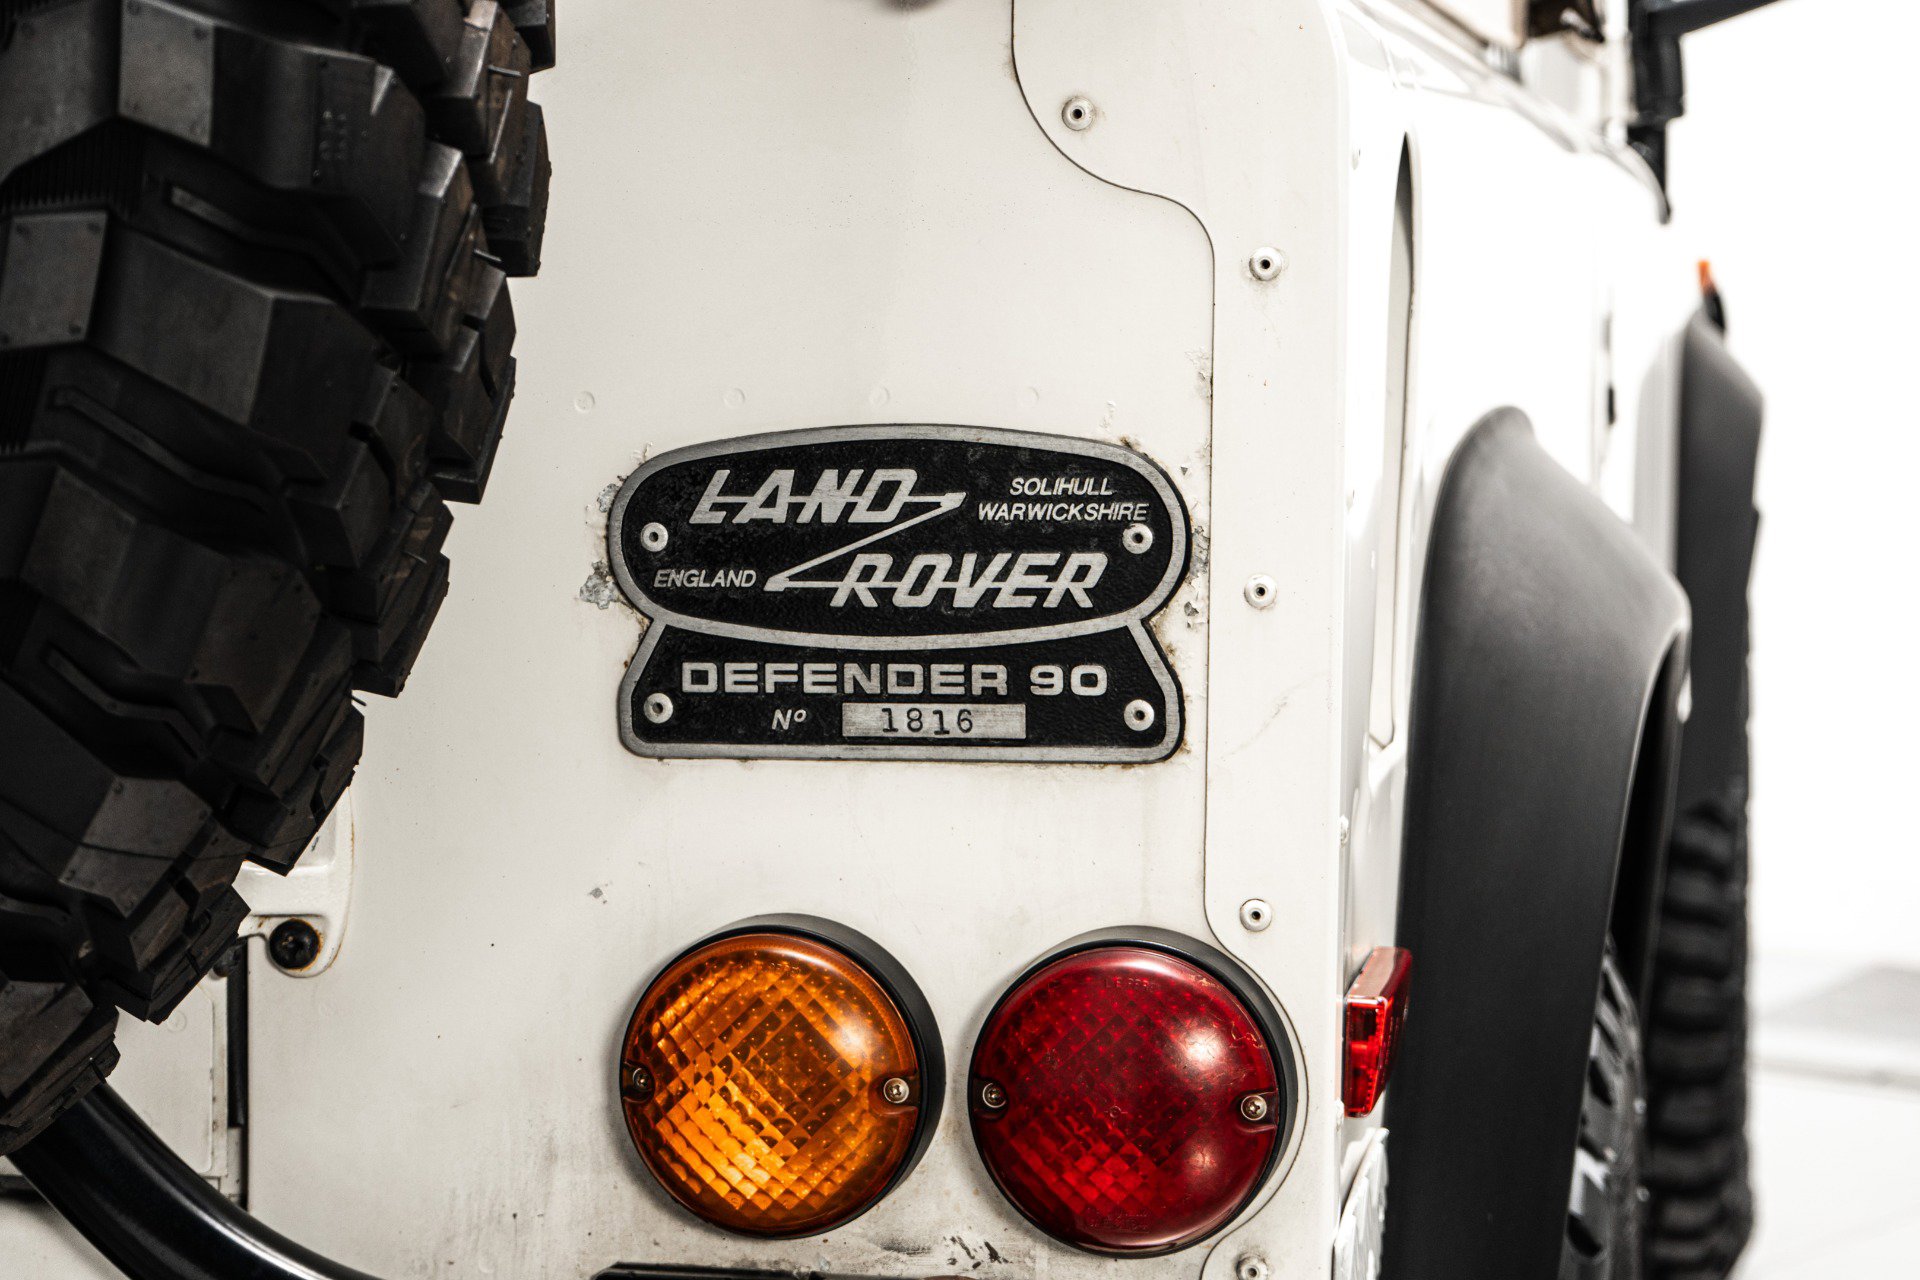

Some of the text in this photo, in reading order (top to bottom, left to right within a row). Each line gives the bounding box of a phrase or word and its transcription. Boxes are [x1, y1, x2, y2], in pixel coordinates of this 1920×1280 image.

[689, 469, 918, 525] LAND
[1009, 476, 1113, 496] SOLIHULL
[978, 502, 1149, 522] WARWICKSHIRE
[653, 569, 757, 589] ENGLAND
[829, 553, 1109, 608] ROVER
[681, 662, 1108, 697] DEFENDER 90
[881, 707, 974, 734] 1816
